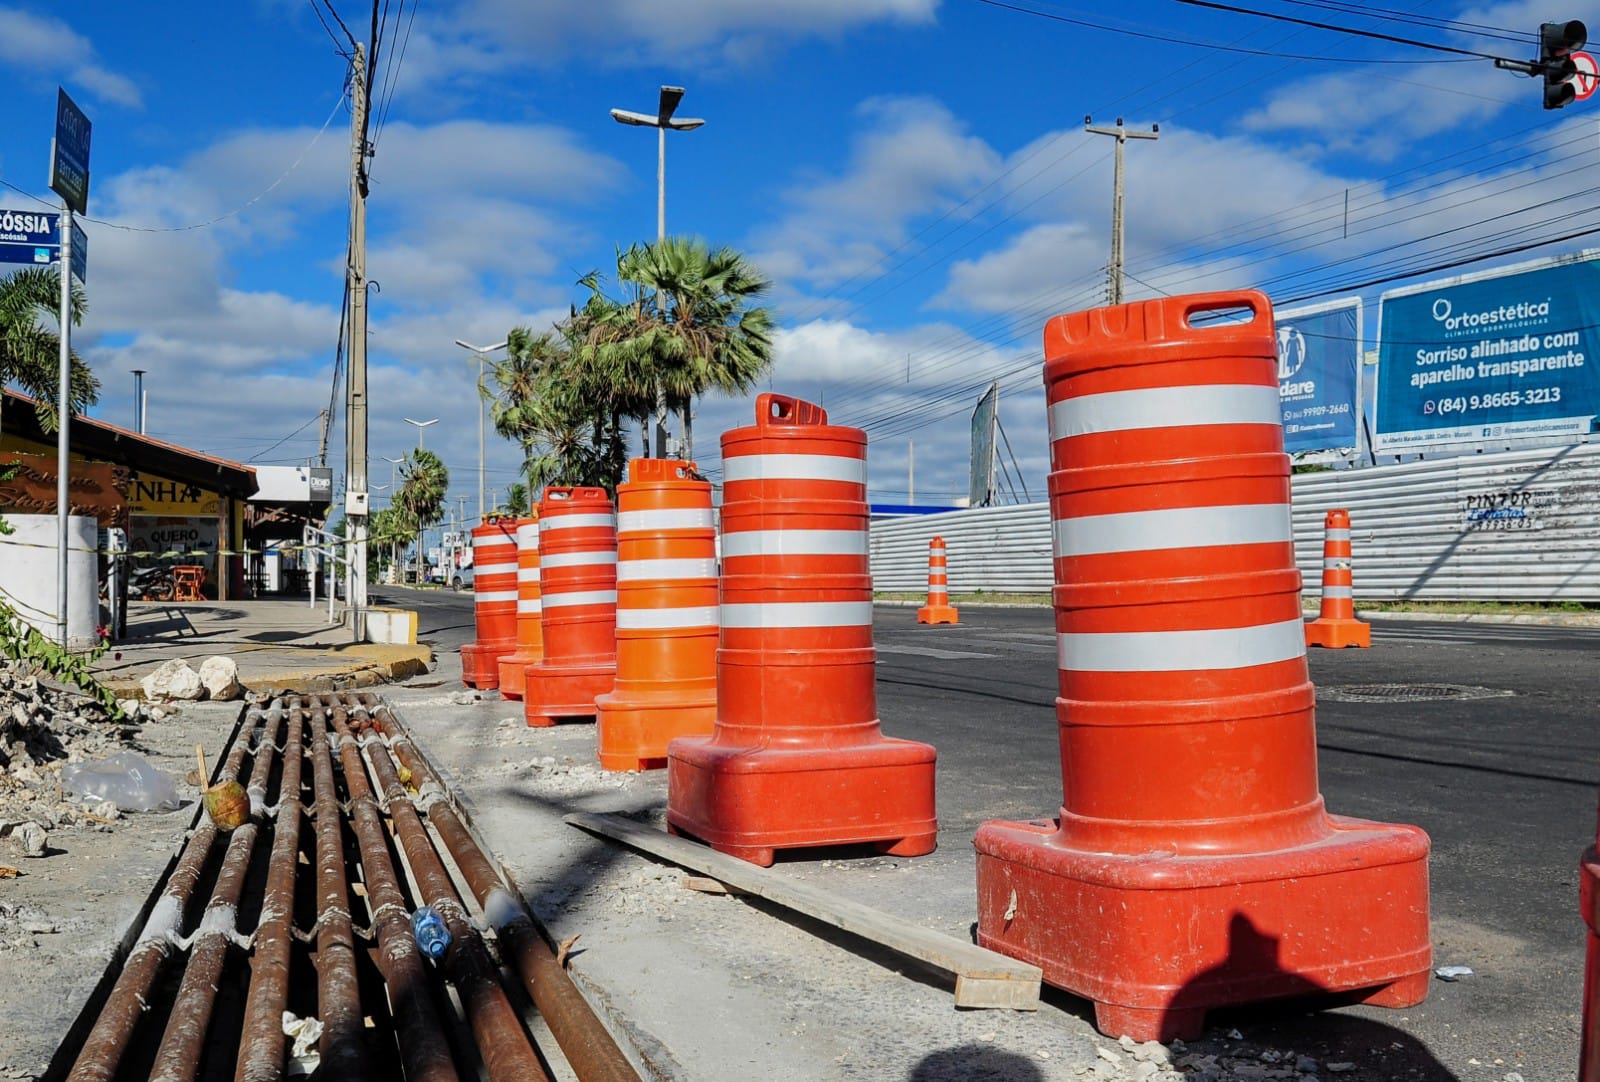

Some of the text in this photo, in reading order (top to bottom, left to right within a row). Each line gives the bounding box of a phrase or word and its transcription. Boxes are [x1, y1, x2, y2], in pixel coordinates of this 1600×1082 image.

[0, 211, 50, 234] ÓSSIA
[0, 233, 28, 241] scóssia
[1416, 332, 1579, 366] Sorriso alinhado com
[1410, 351, 1585, 388] aparelho transparente
[1280, 381, 1315, 396] dare
[1303, 403, 1349, 417] 99909-2660
[1437, 387, 1561, 416] (84) 9.8665-3213
[129, 481, 199, 503] NHA
[1467, 491, 1532, 509] PINTOR
[150, 529, 199, 543] QUERO
